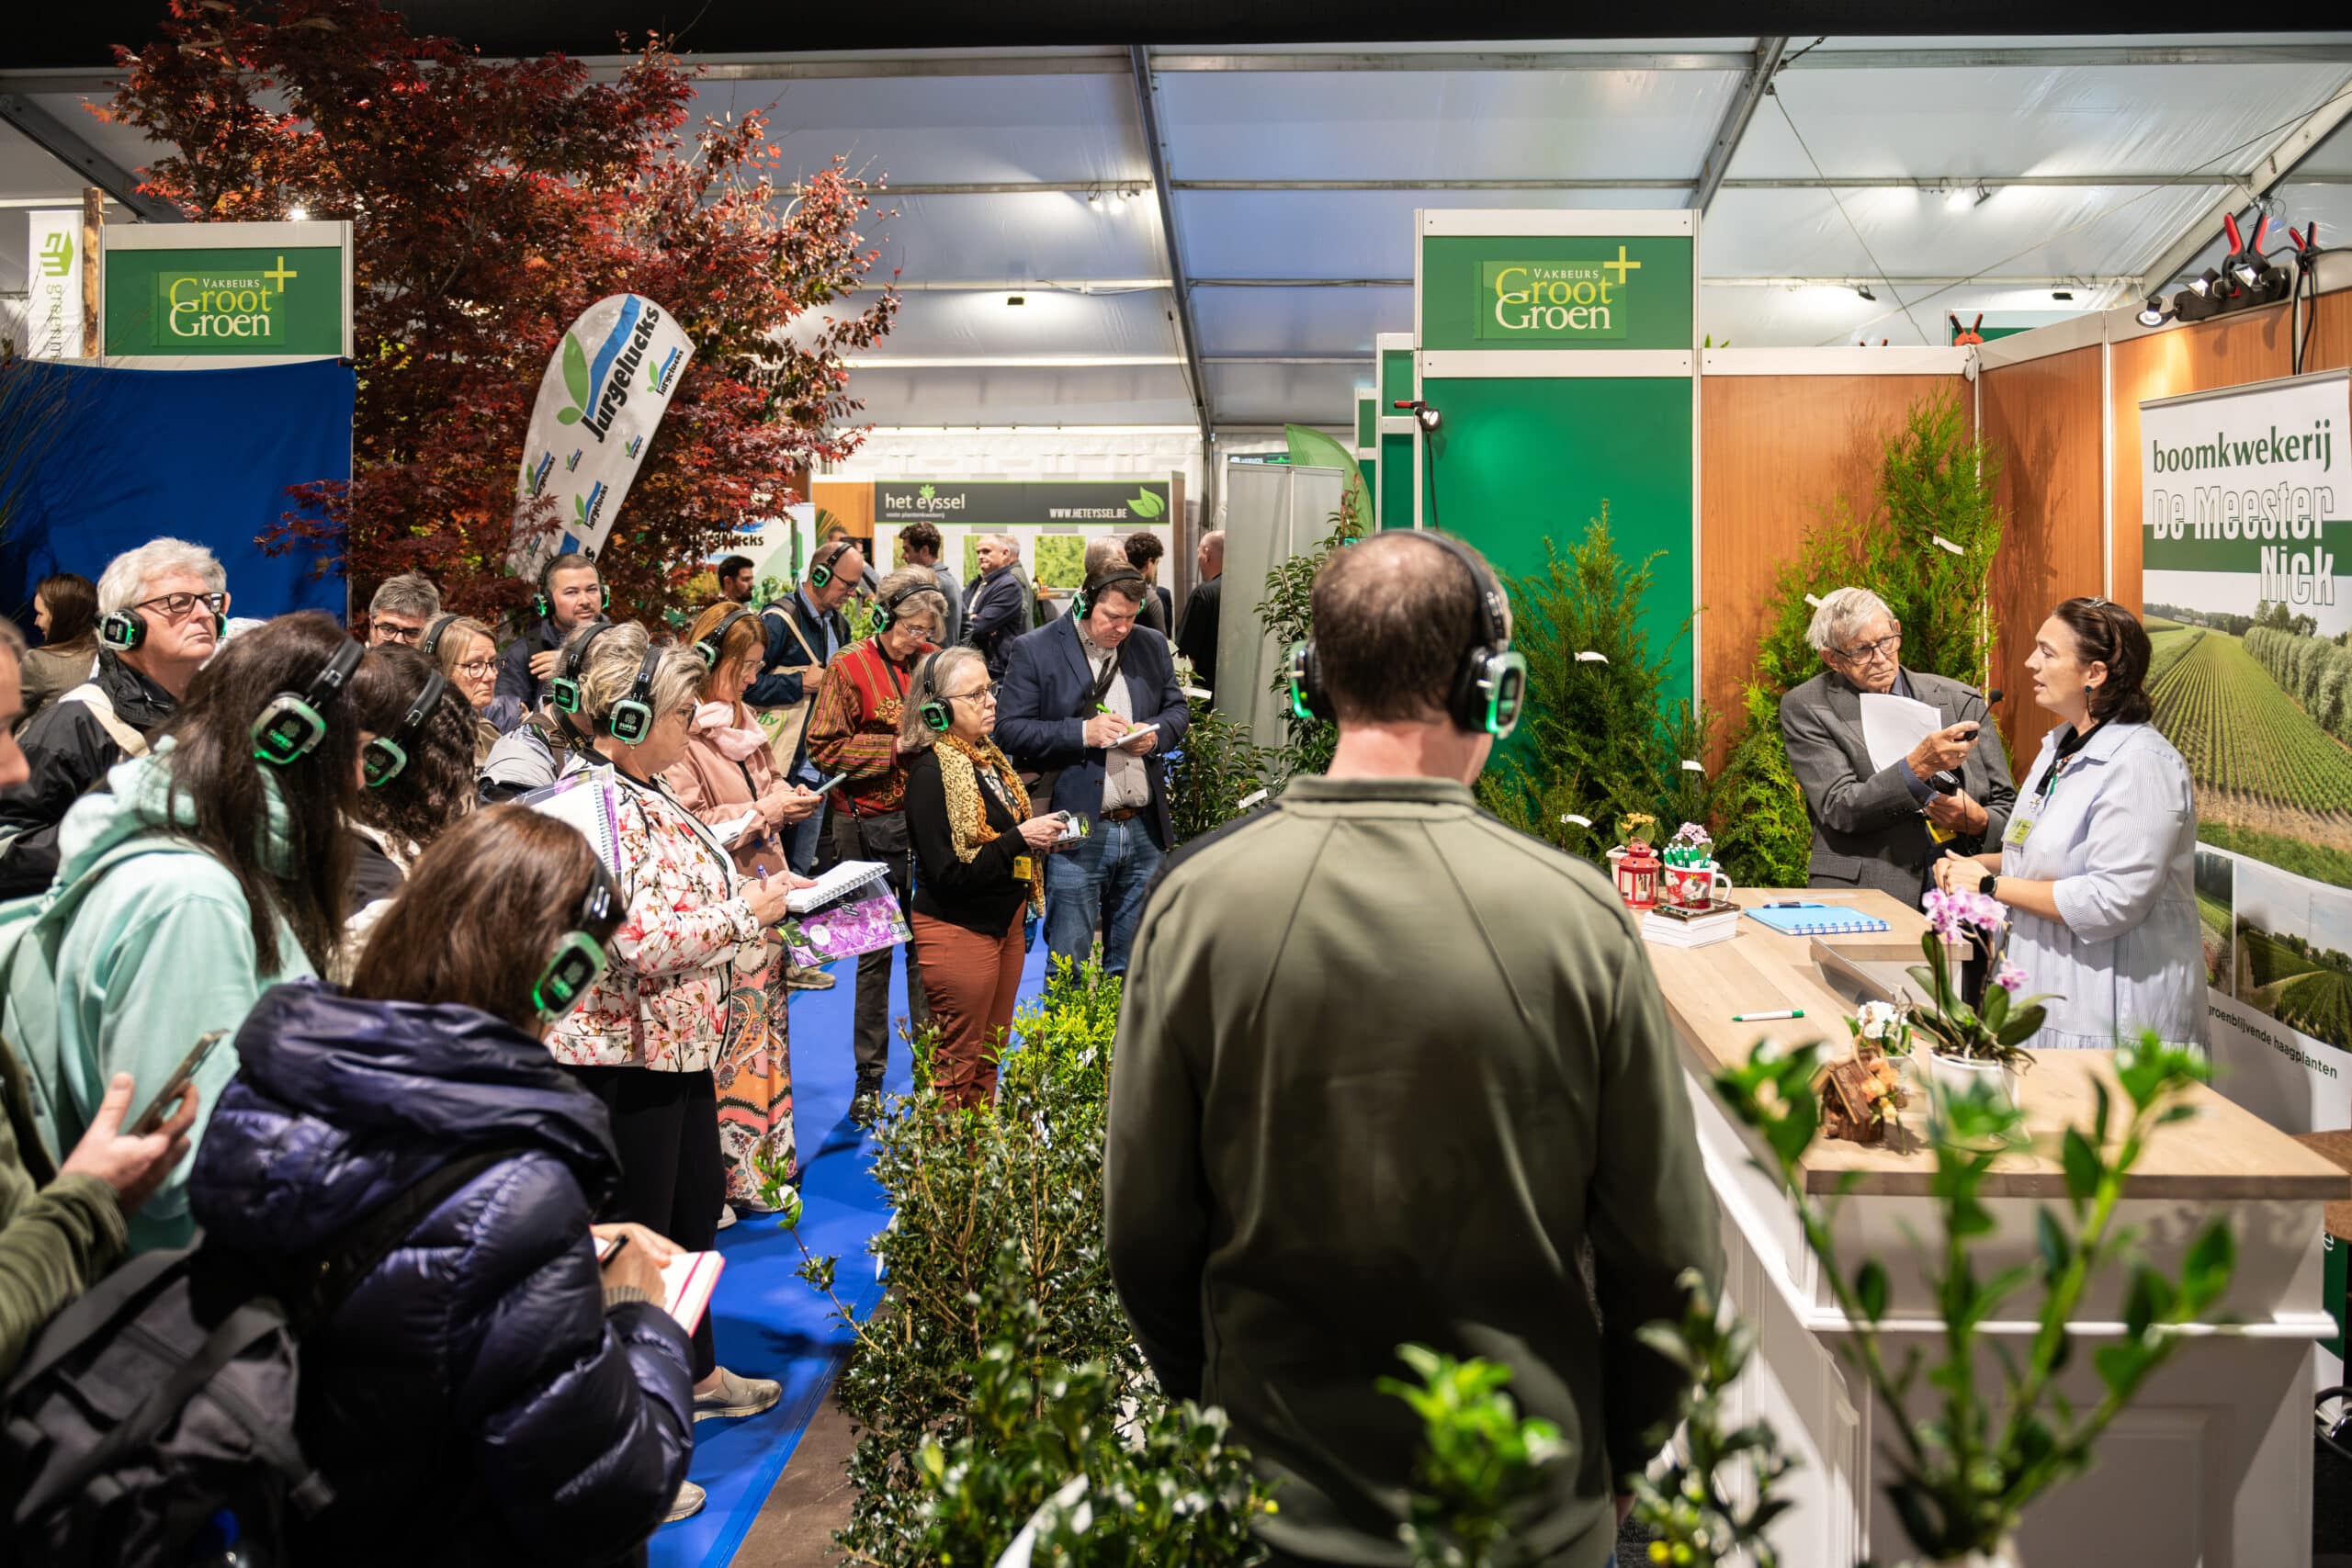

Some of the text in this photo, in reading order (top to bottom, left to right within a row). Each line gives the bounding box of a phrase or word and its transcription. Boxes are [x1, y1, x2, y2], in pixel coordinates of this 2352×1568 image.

[202, 278, 260, 288] VAKBEURS
[1495, 267, 1613, 304] Groot
[1533, 268, 1599, 279] VAKBEURS
[169, 277, 273, 313] Groot
[1495, 292, 1611, 330] Groen
[169, 301, 272, 337] Groen
[581, 306, 660, 443] Jurgelucks
[655, 350, 684, 397] Jurgelucks
[2154, 419, 2331, 473] boomkwekerij
[583, 484, 608, 530] Jurgelucks
[885, 492, 966, 513] het eyssel
[2154, 480, 2334, 540] De Meester
[2260, 545, 2335, 606] Nick
[2274, 1035, 2337, 1079] haagplanten
